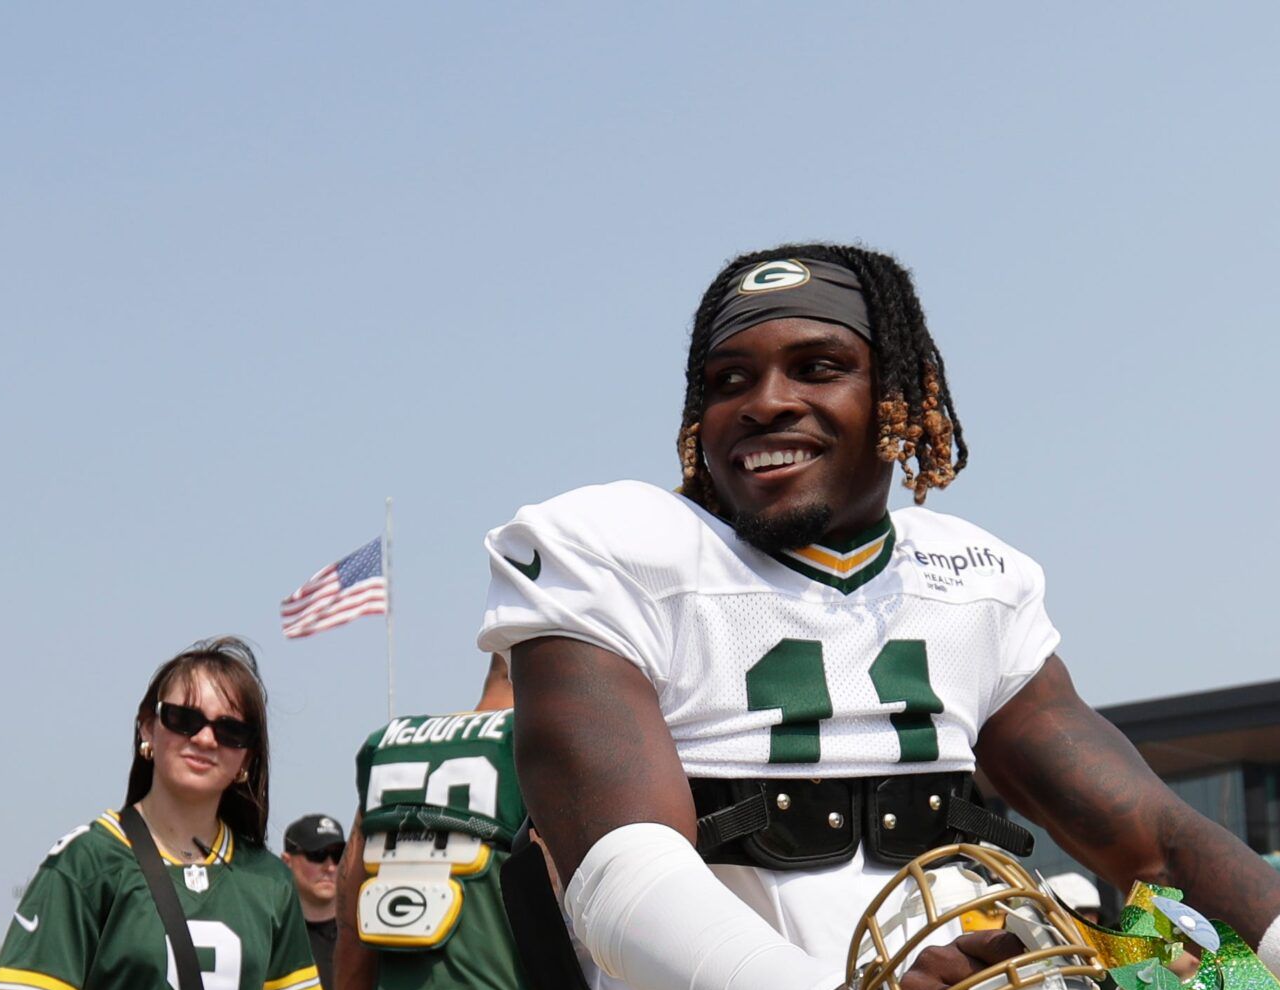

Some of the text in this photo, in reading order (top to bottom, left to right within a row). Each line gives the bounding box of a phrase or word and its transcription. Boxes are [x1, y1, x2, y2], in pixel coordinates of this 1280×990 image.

[914, 546, 1005, 576] emplify
[923, 571, 964, 587] HEALTH
[746, 638, 944, 763] 11
